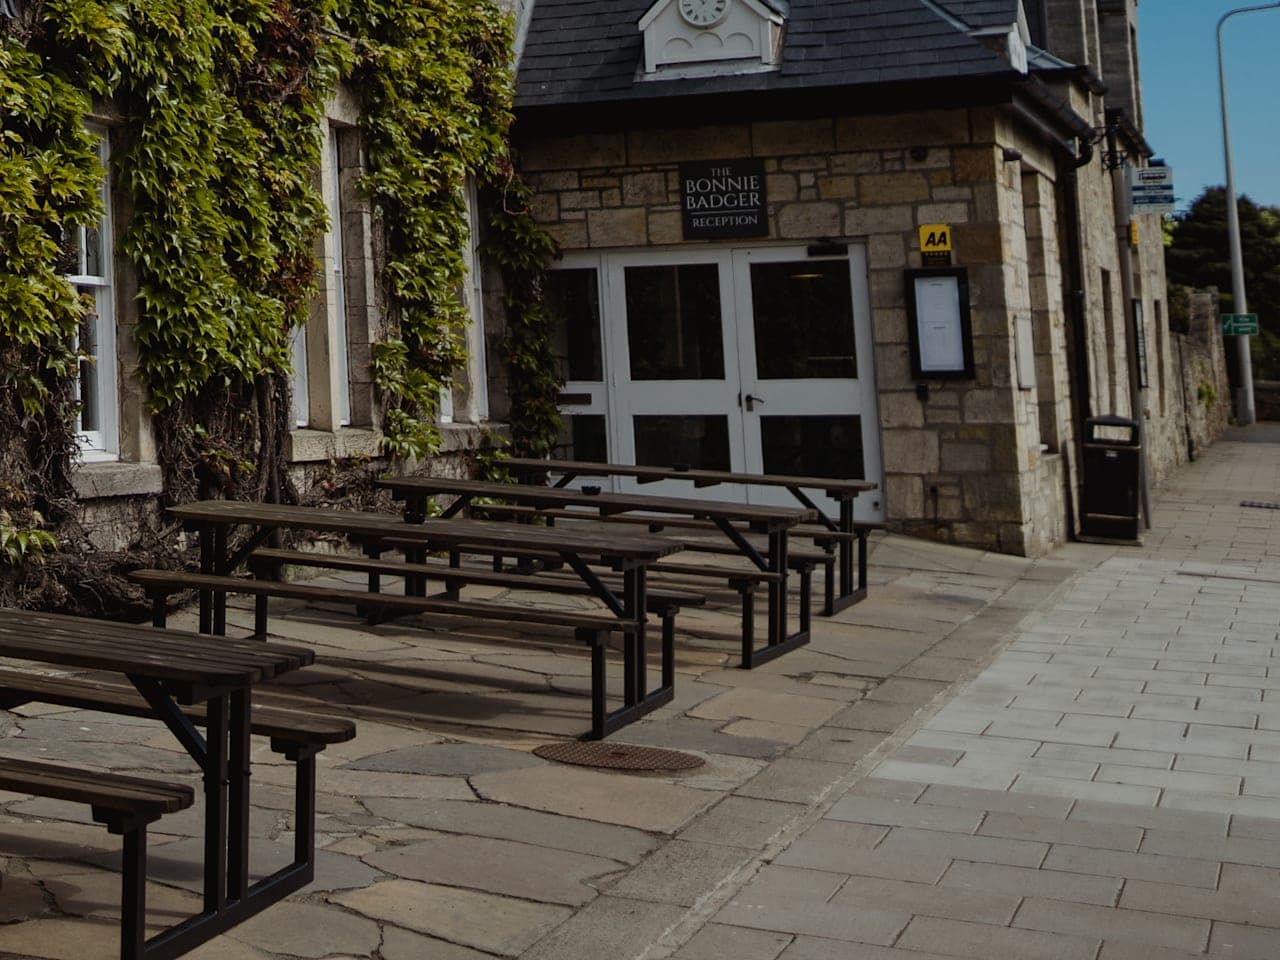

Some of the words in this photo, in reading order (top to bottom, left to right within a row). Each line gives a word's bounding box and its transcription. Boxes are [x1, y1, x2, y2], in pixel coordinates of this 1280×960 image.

[710, 167, 732, 177] THE
[686, 175, 760, 193] BONNIE
[686, 191, 761, 209] BADGER
[692, 215, 758, 228] RECEPTION
[924, 231, 948, 247] AA
